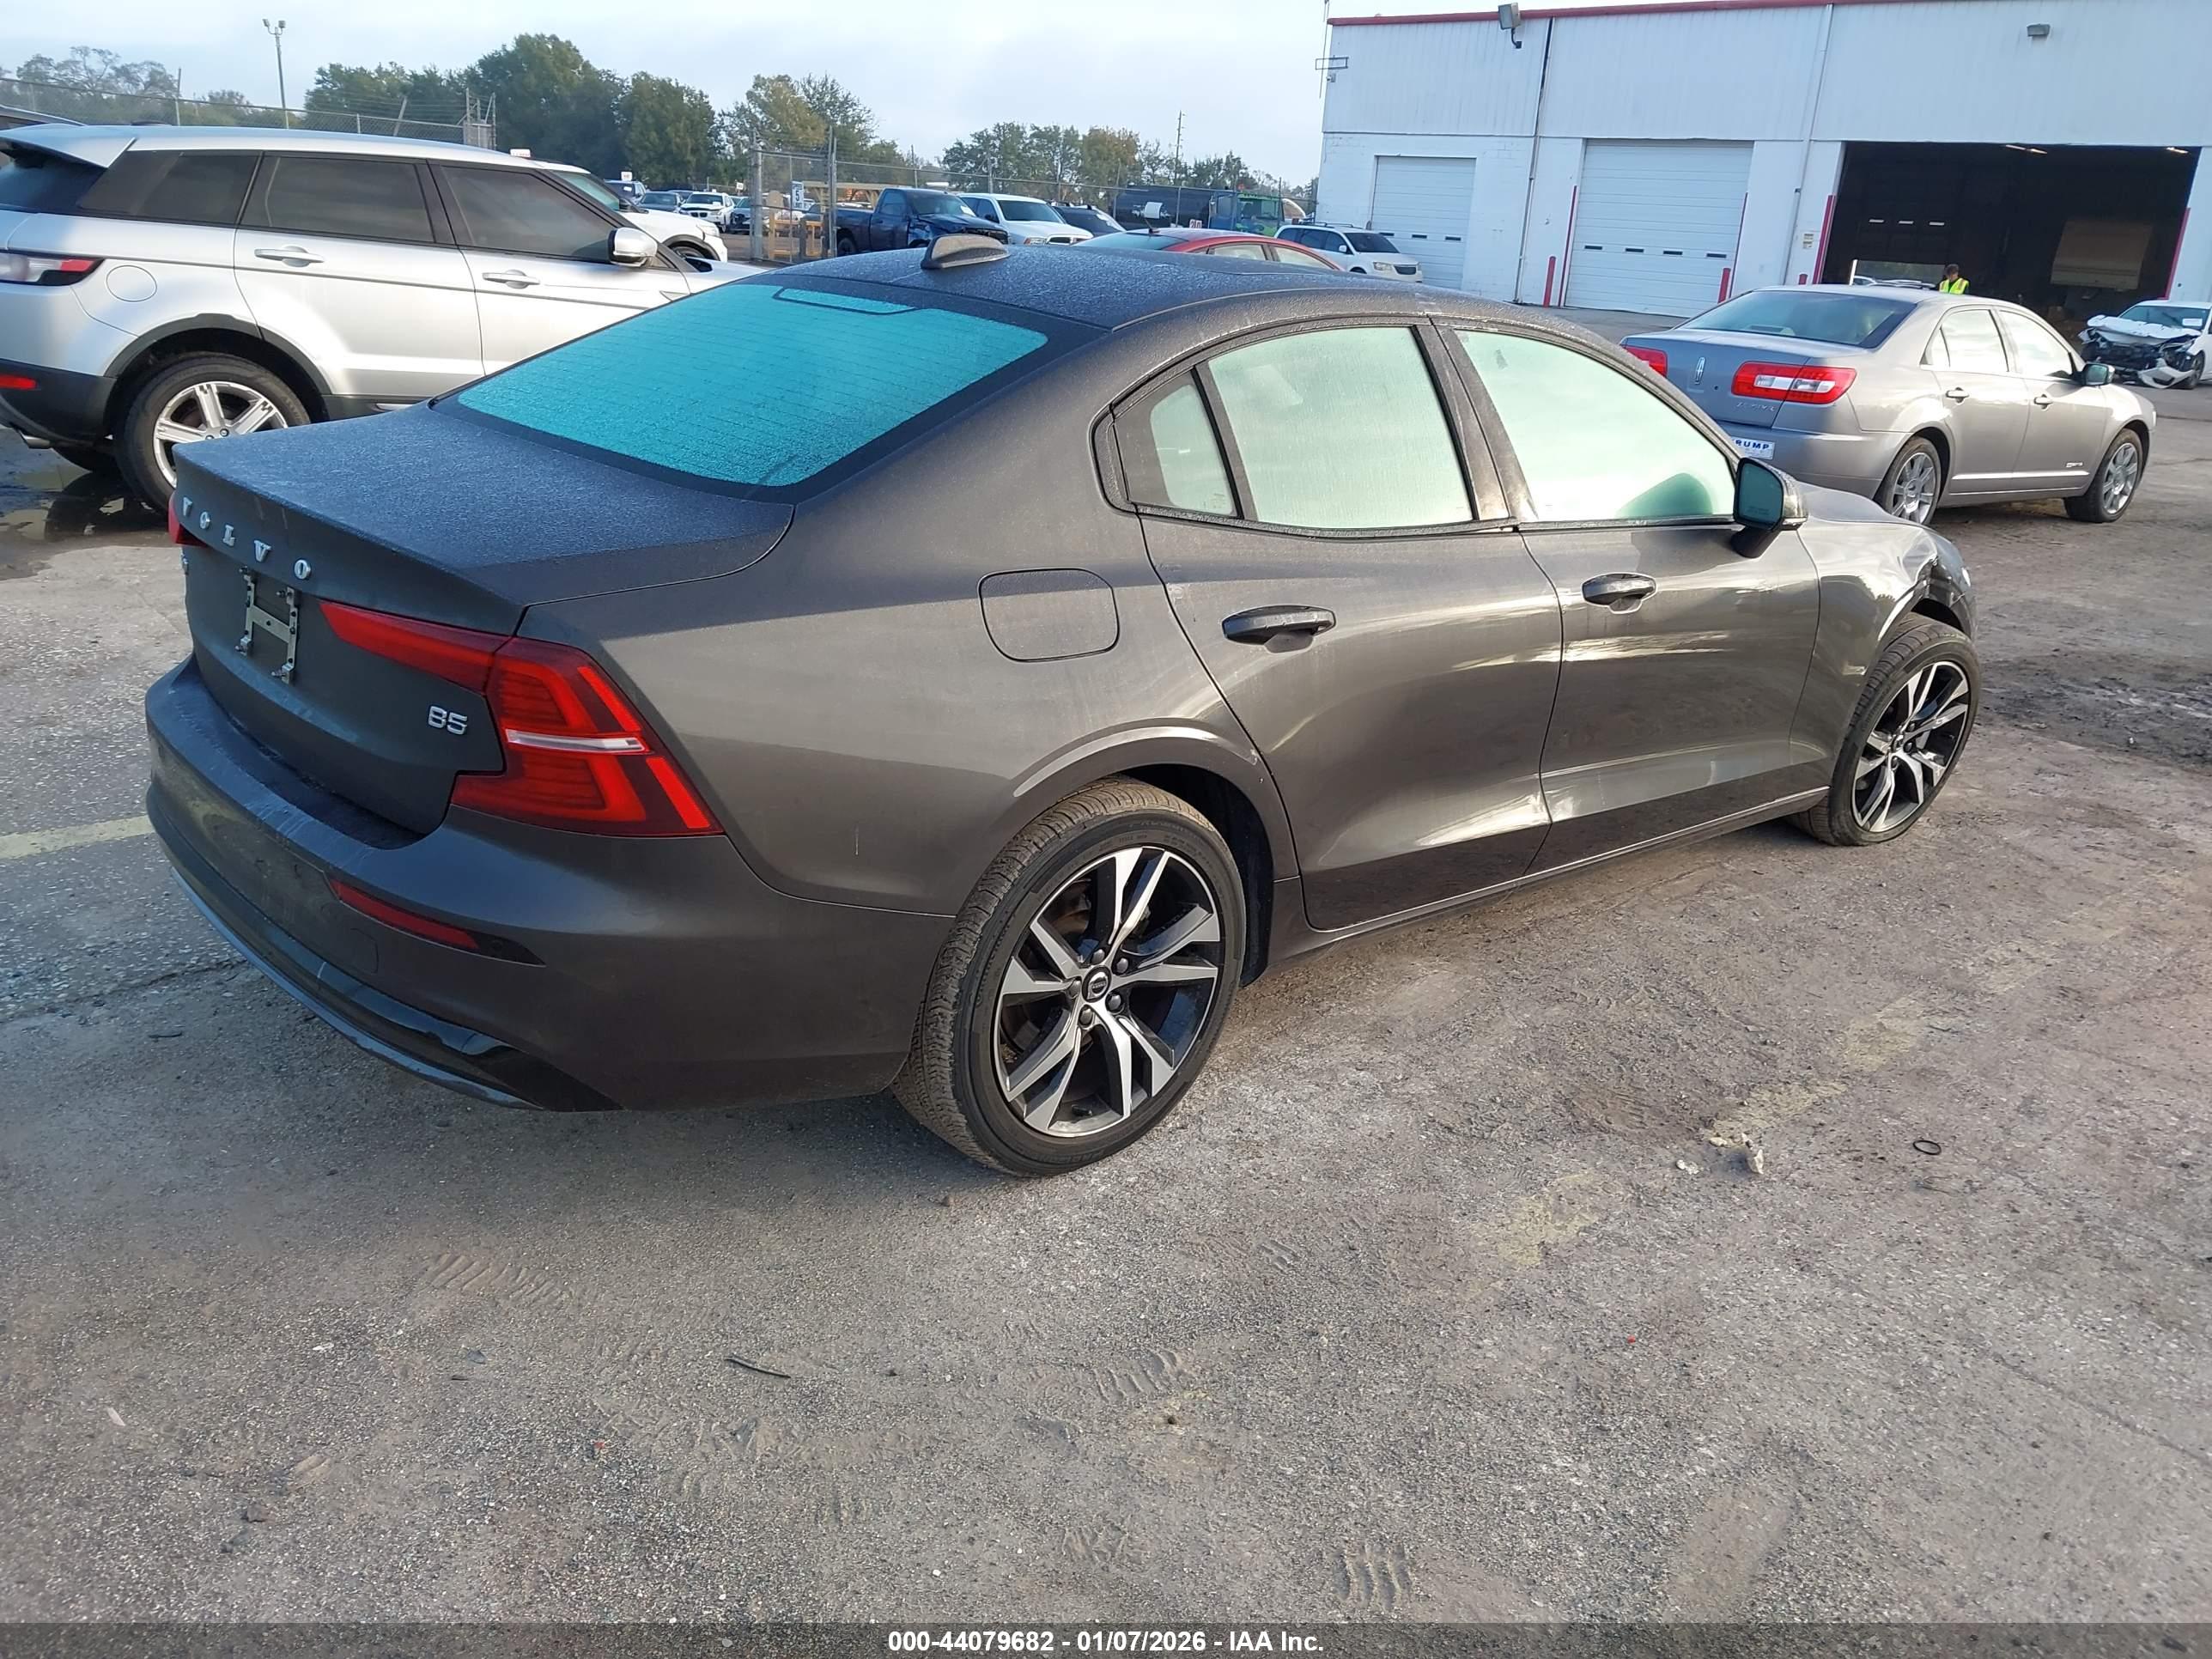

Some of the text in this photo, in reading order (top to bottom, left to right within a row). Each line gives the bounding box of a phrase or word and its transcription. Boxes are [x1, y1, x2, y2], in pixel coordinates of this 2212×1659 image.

[1732, 439, 1770, 450] RUMP
[182, 496, 311, 580] VOLVO
[428, 706, 467, 735] B5
